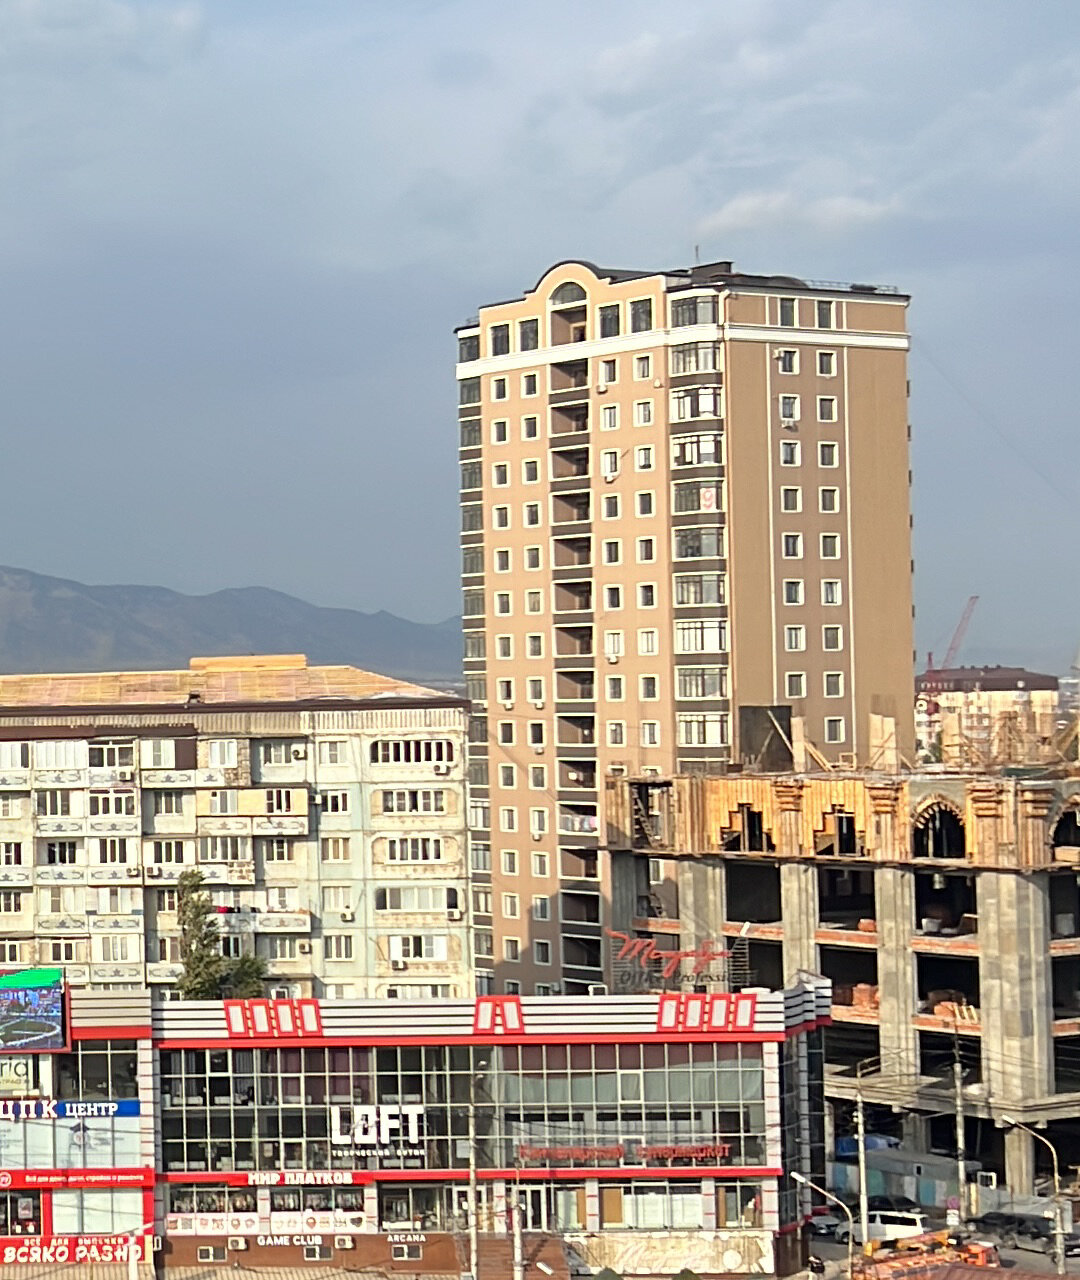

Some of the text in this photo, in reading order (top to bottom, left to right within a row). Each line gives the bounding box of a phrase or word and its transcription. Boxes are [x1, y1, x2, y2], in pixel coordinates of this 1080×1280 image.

[65, 1102, 119, 1117] ЦЕНТР
[331, 1104, 425, 1145] LOFT
[248, 1172, 353, 1185] МИР ПЛАТКОВ
[257, 1235, 323, 1246] GAME CLUB
[387, 1234, 426, 1243] ARCANA
[3, 1245, 69, 1263] ВСЯКО
